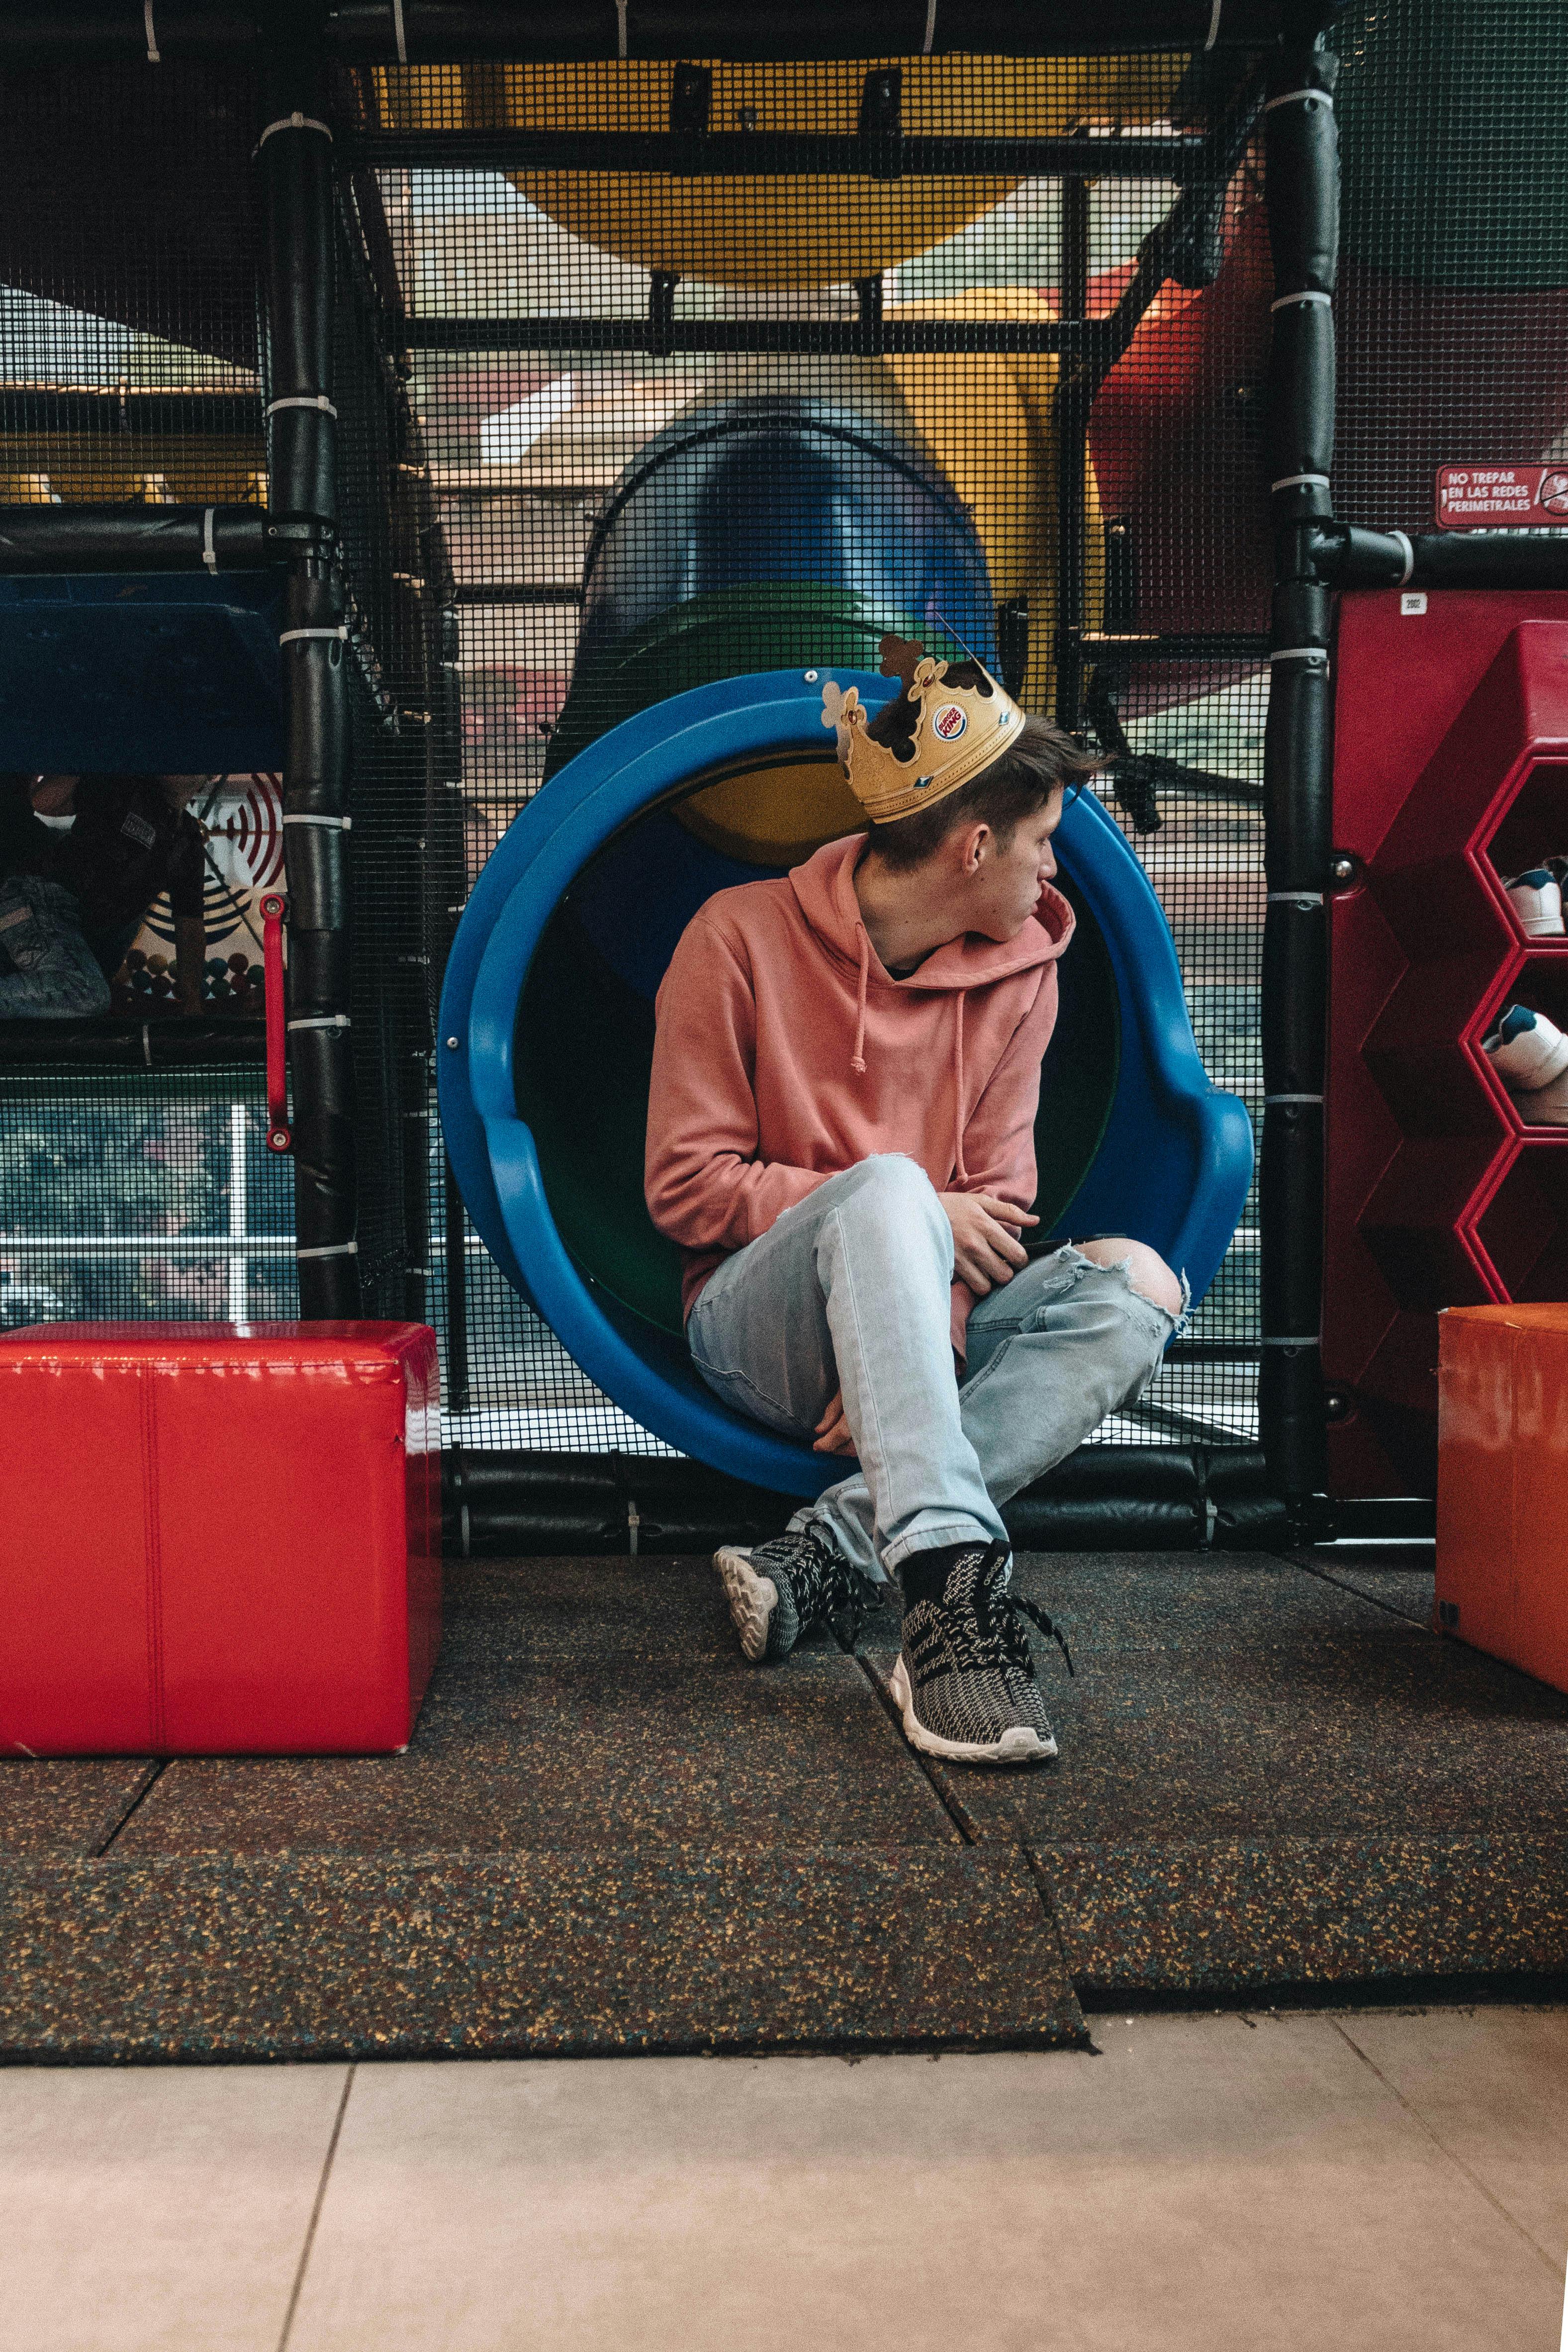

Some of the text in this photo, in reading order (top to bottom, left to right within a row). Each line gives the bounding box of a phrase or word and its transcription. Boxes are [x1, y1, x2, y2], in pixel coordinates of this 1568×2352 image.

[1448, 472, 1515, 484] NO TREPAR
[1448, 485, 1528, 498] EN LAS REDES
[1448, 500, 1530, 512] PERIMETRALES
[938, 707, 957, 731] BURGER
[942, 711, 961, 738] KING
[983, 1556, 1004, 1585] adidas
